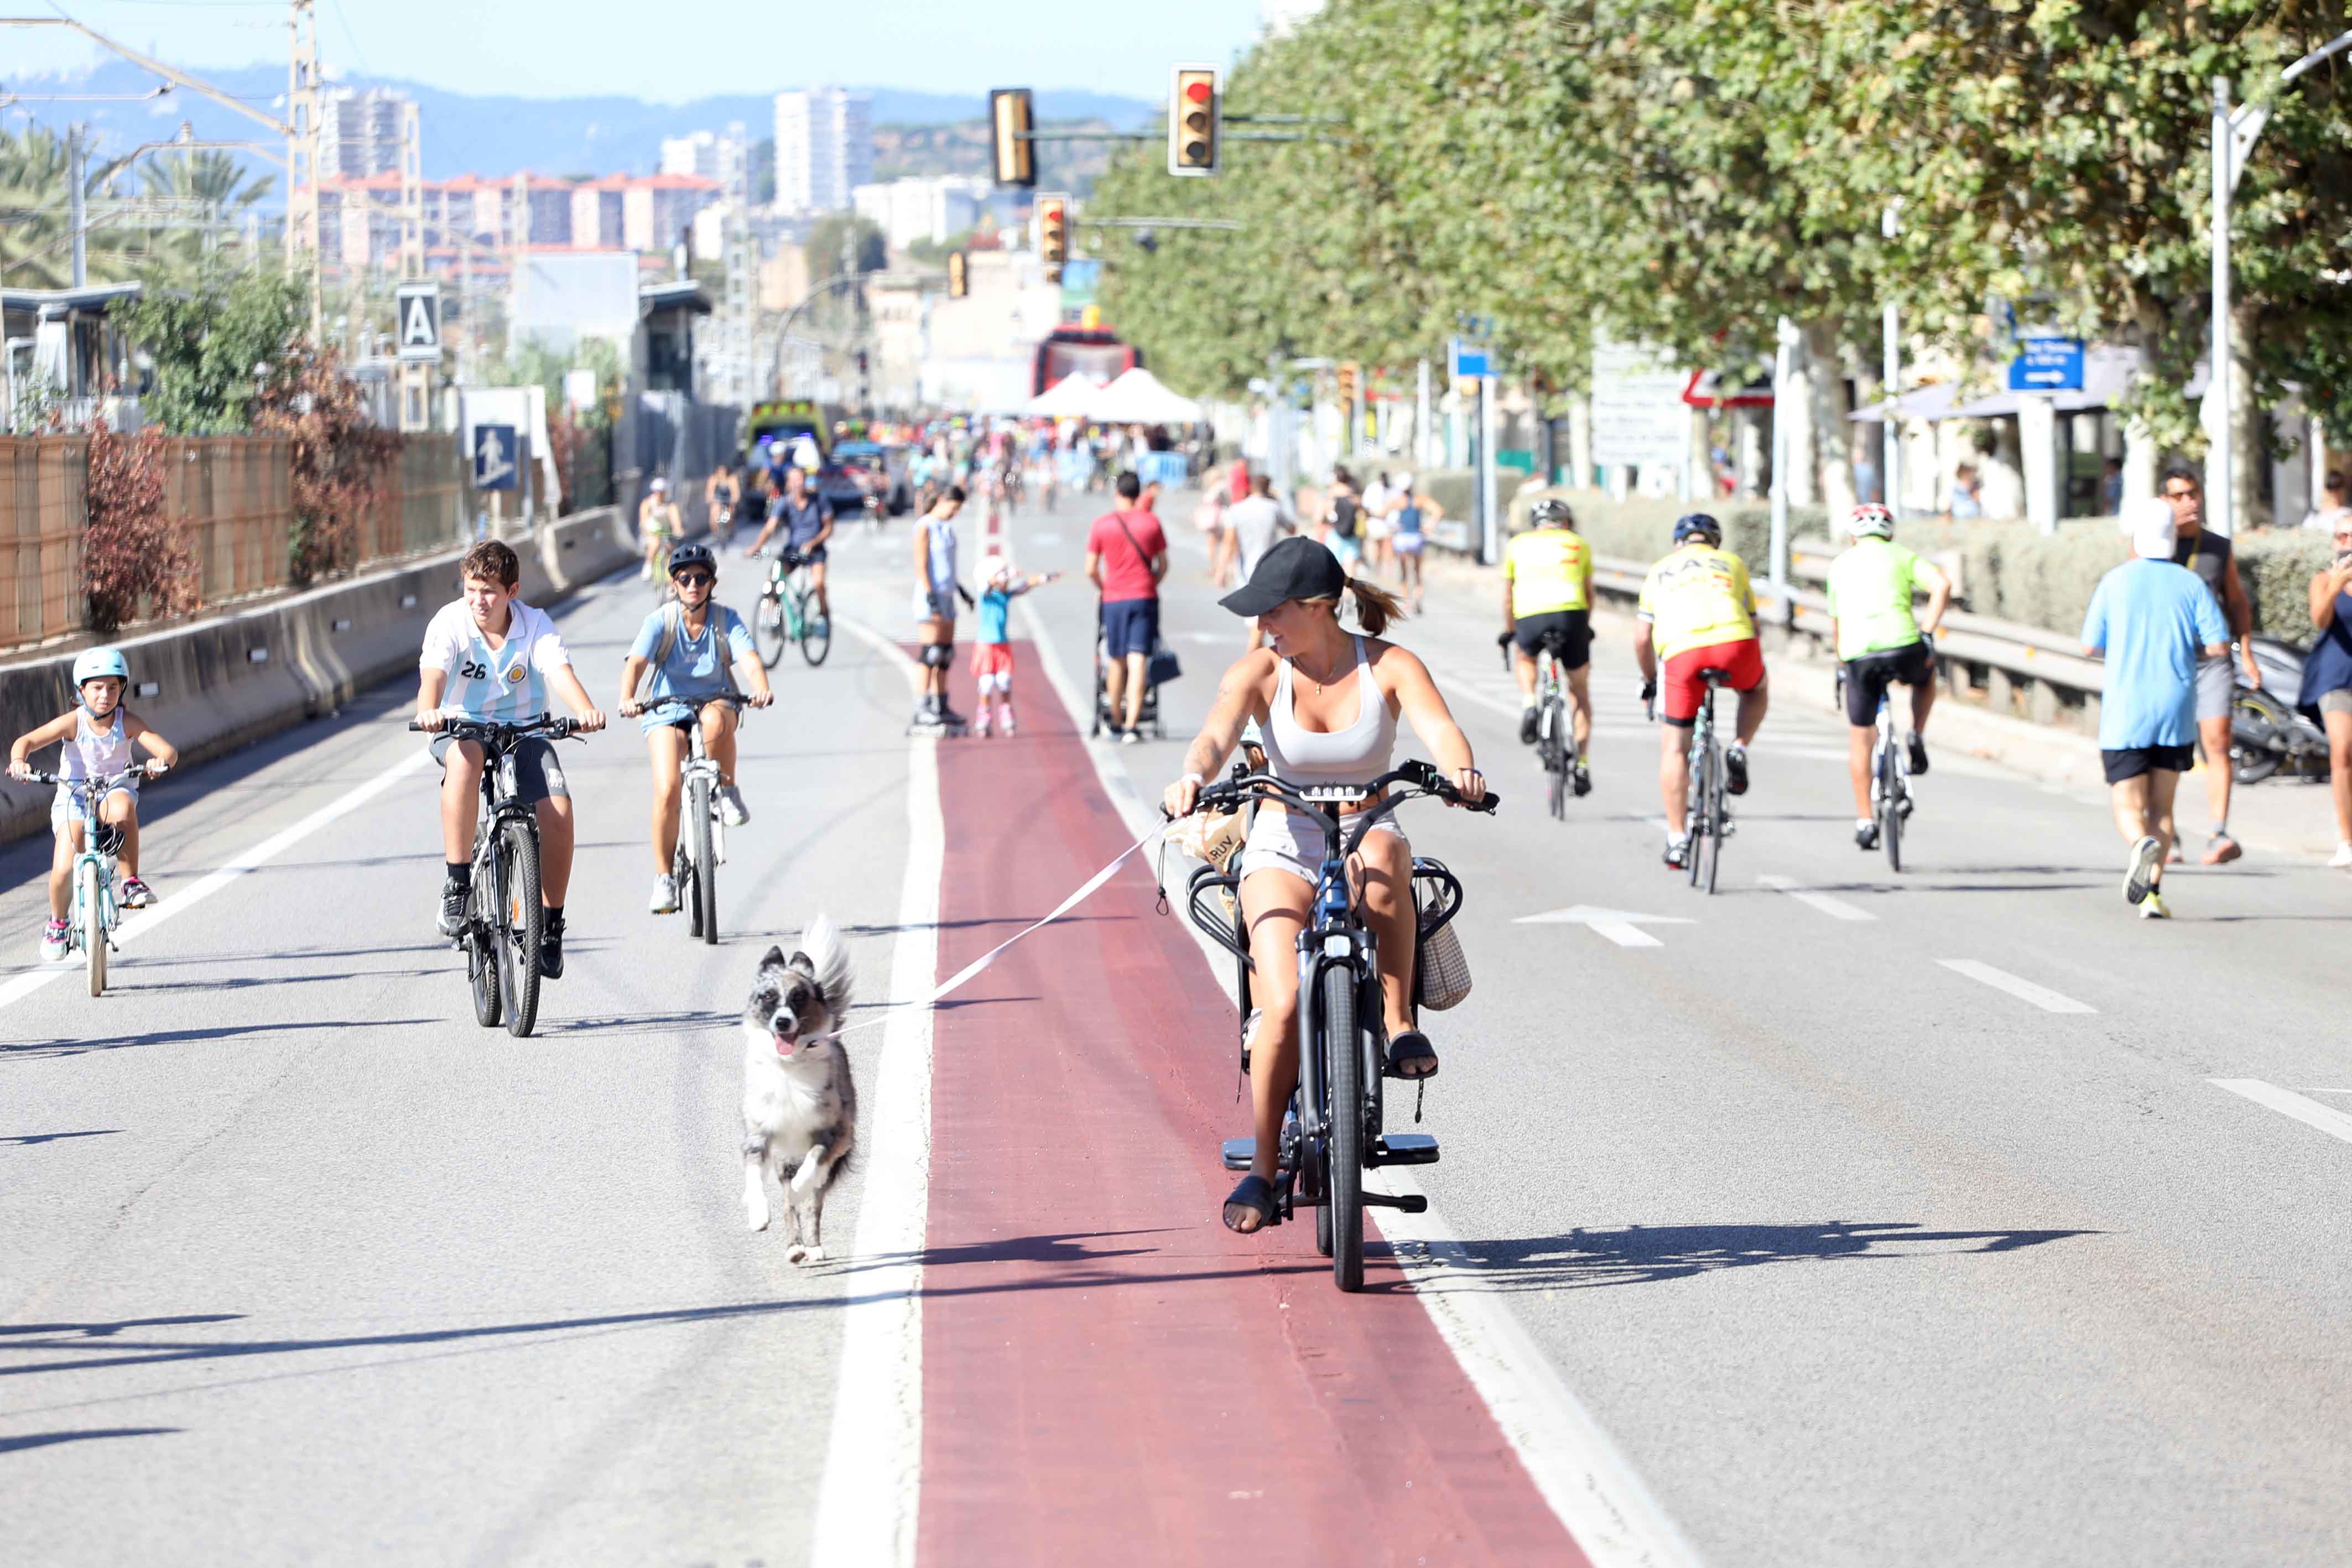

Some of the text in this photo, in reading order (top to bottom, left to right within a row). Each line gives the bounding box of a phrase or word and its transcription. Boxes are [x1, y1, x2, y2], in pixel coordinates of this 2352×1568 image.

[403, 296, 435, 345] A
[461, 660, 487, 680] 26
[1210, 834, 1232, 861] RUV
